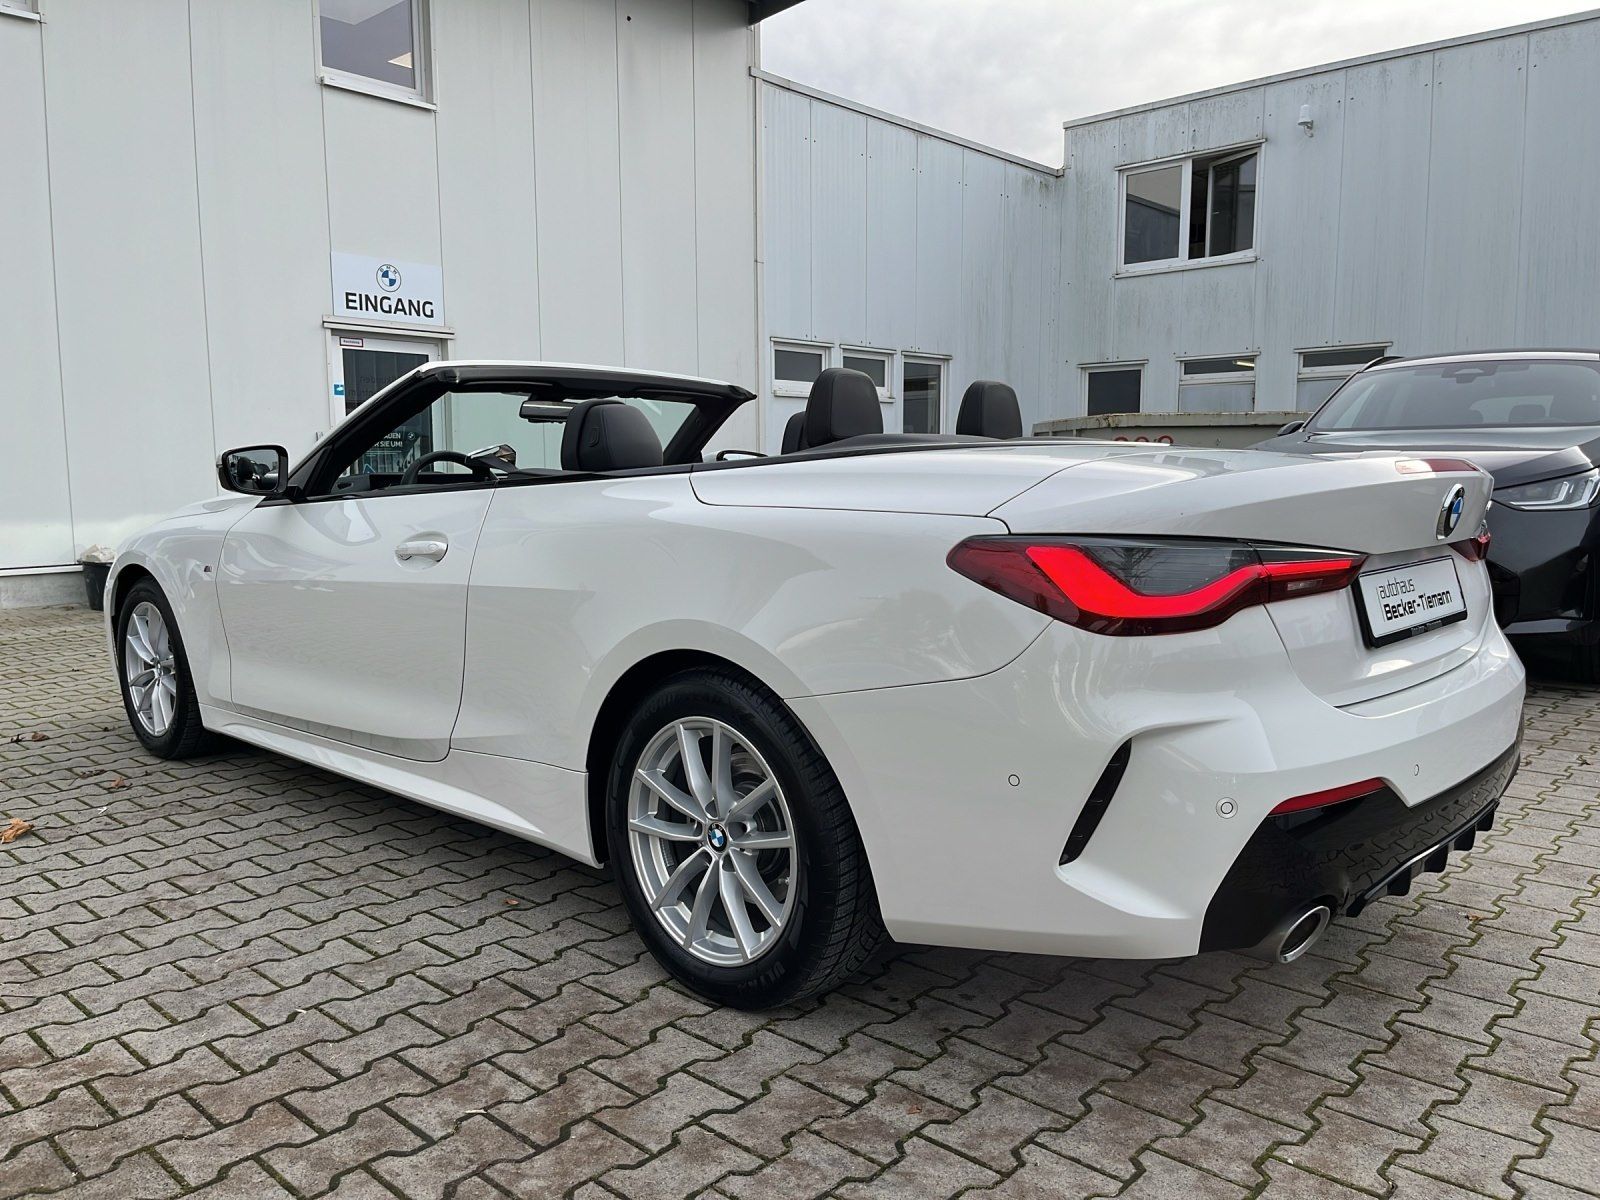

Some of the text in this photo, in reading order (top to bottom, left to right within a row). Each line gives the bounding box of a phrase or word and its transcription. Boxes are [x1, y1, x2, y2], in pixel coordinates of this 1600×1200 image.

[345, 292, 434, 318] EINGANG
[1378, 577, 1415, 599] autohaus
[1383, 590, 1453, 621] Becker-Tiemann
